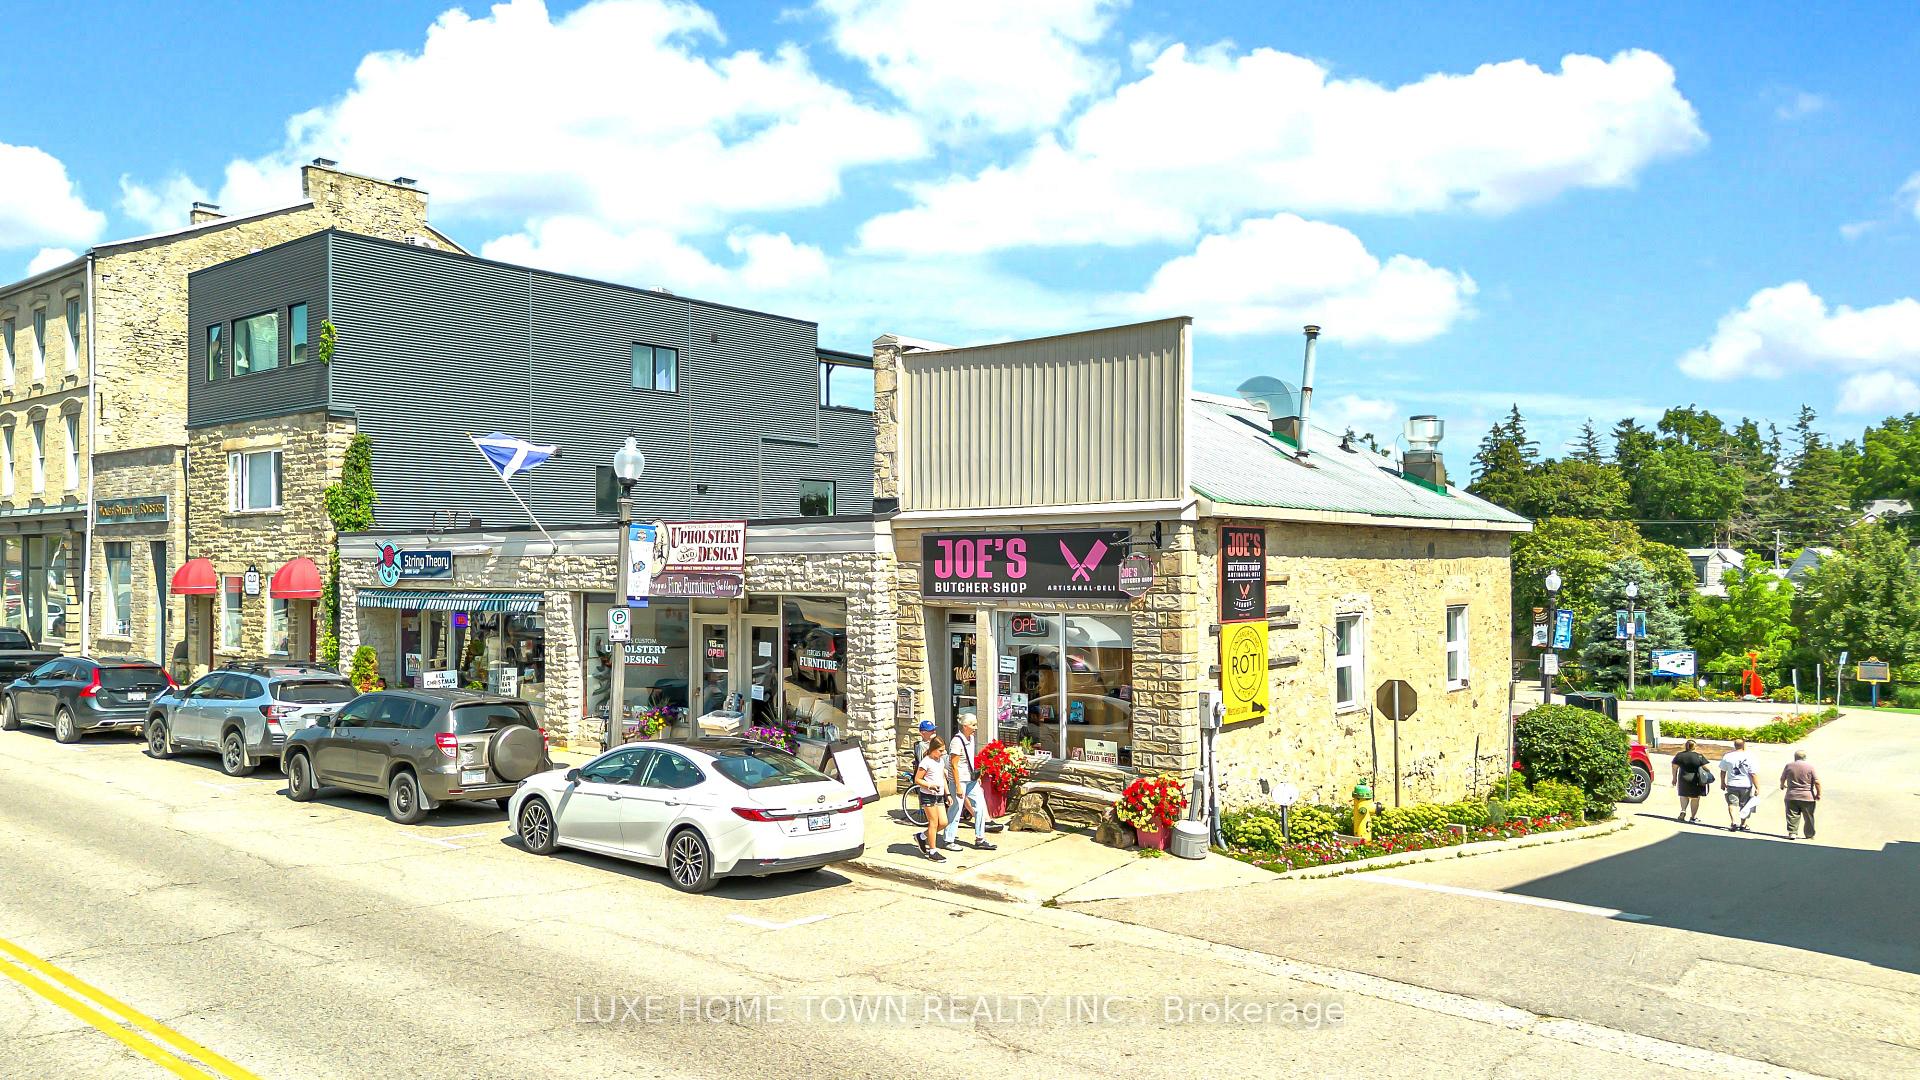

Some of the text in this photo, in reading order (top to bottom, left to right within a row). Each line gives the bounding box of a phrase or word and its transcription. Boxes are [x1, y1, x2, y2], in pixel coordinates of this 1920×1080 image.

[671, 527, 741, 548] UPHOLSTERY
[1227, 532, 1261, 556] JOE'S
[698, 546, 739, 562] DESIGN
[934, 537, 1027, 579] JOE'S
[404, 554, 449, 570] String Theory
[1121, 567, 1138, 578] JOE'S
[667, 576, 683, 594] Fine
[682, 576, 715, 595] Furniture
[934, 582, 1027, 593] BUTCHER SHOP
[1012, 618, 1046, 632] OPEN
[605, 645, 668, 654] UOLSTERY
[708, 640, 717, 648] YES
[707, 648, 725, 657] OPEN
[624, 656, 659, 665] DESIGN
[799, 656, 838, 671] FURNITURE
[1231, 652, 1261, 676] ROTI
[426, 678, 456, 686] CHRISTMAS
[1086, 754, 1100, 762] SOLD
